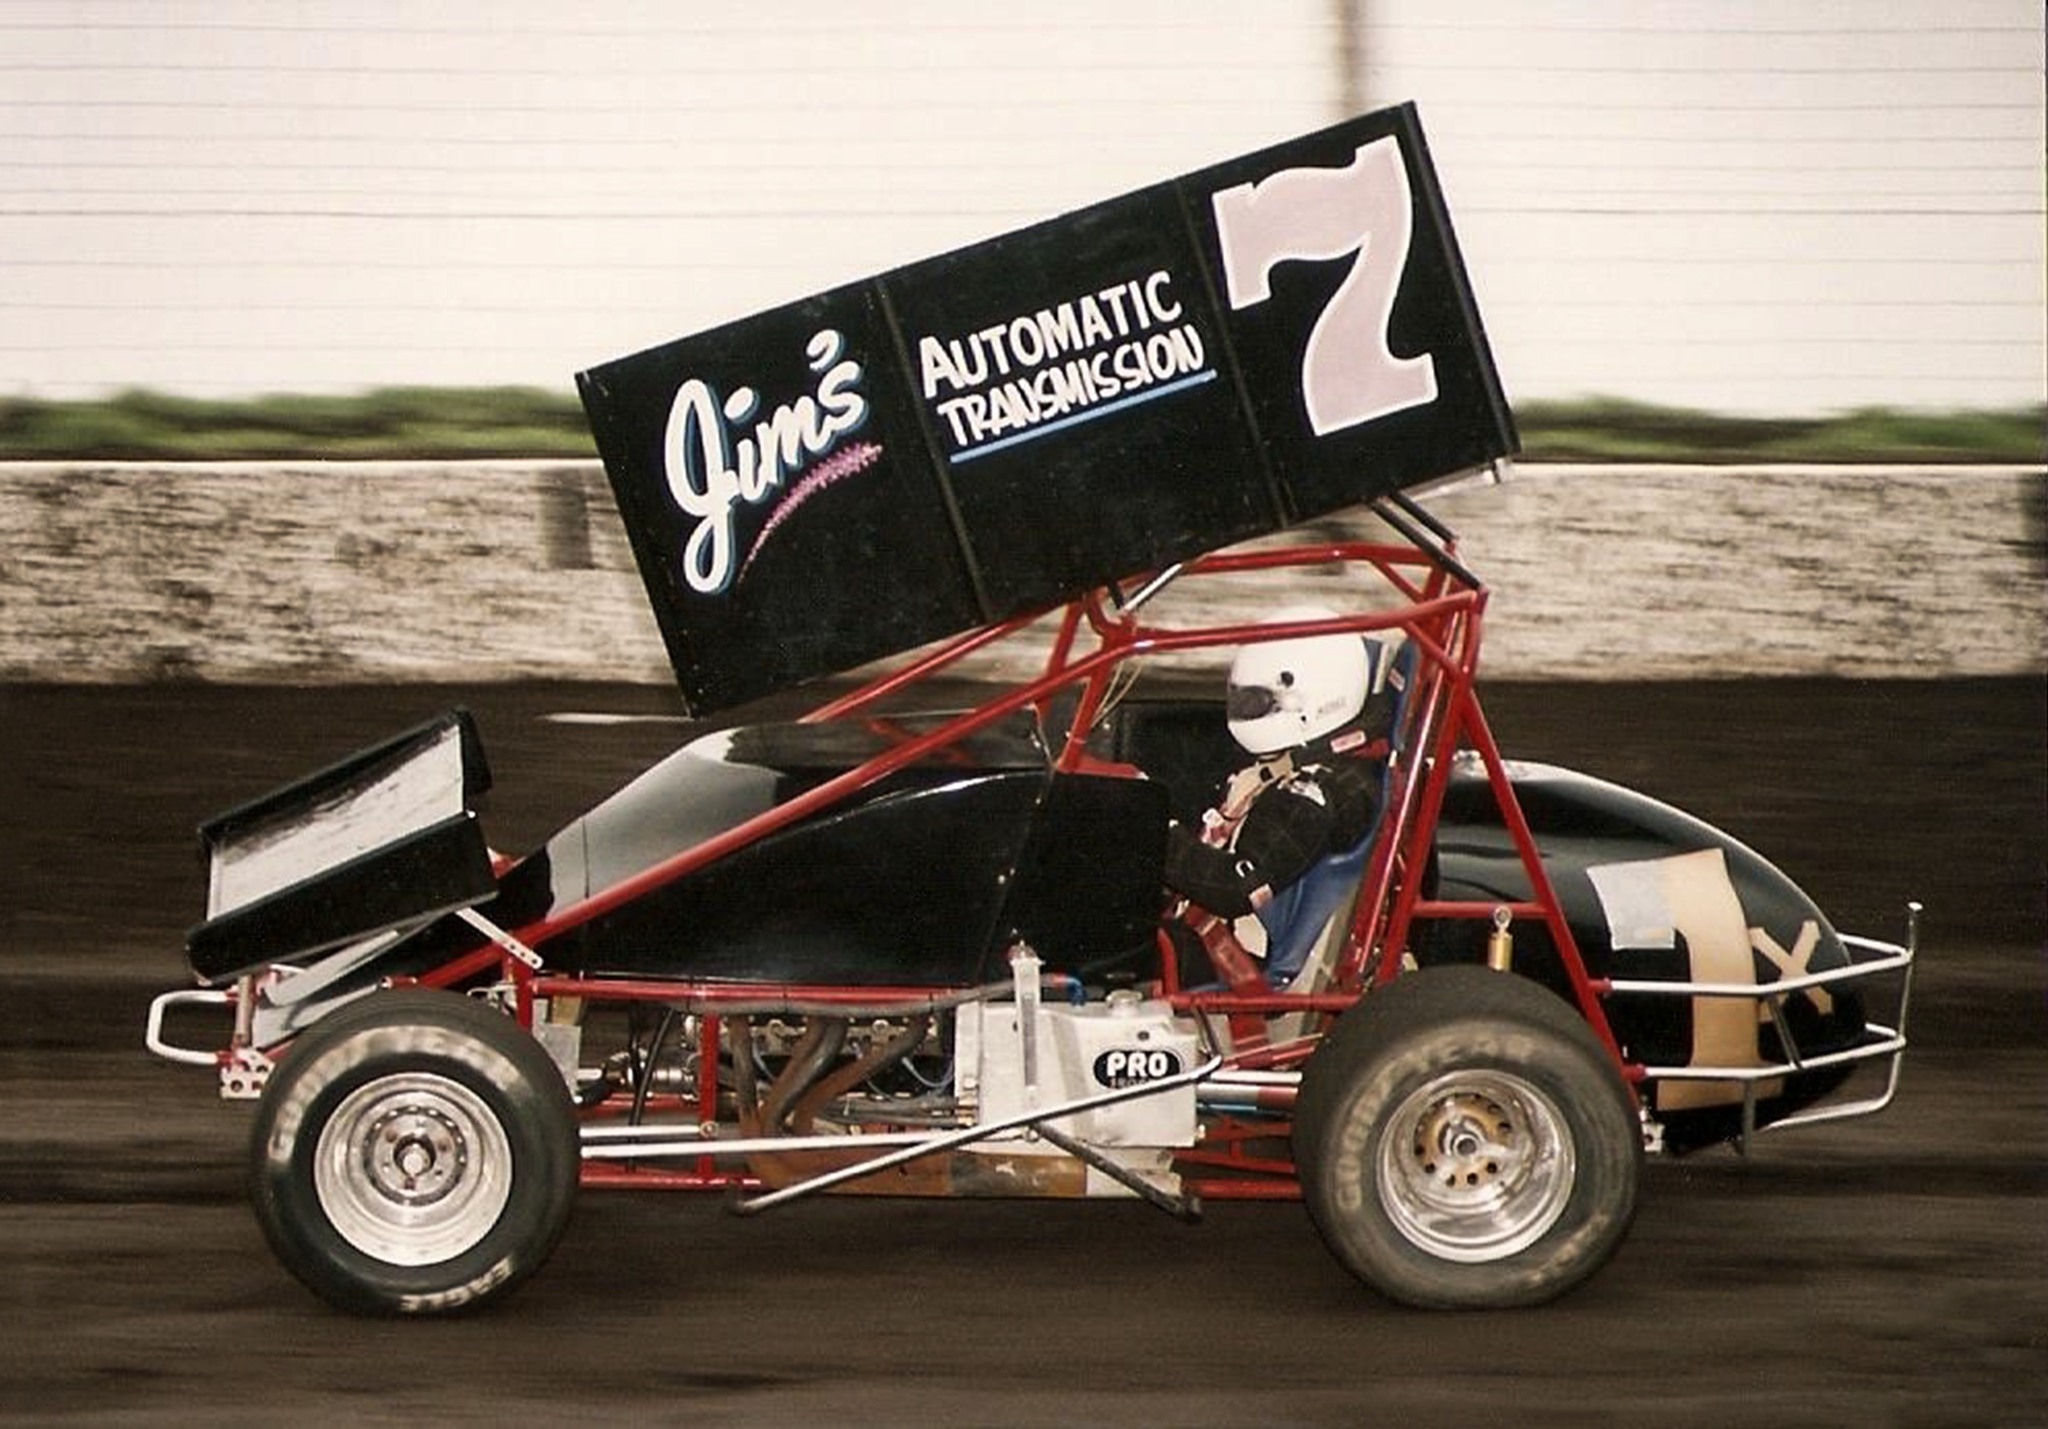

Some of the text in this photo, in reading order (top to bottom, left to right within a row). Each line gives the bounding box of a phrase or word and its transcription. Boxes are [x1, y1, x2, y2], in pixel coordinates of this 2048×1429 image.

[919, 270, 1182, 399] AUTOMATIC
[1211, 133, 1438, 436] 7
[937, 324, 1204, 445] TRANSMISSION
[664, 329, 870, 593] Jim's
[1106, 1051, 1169, 1077] PRO
